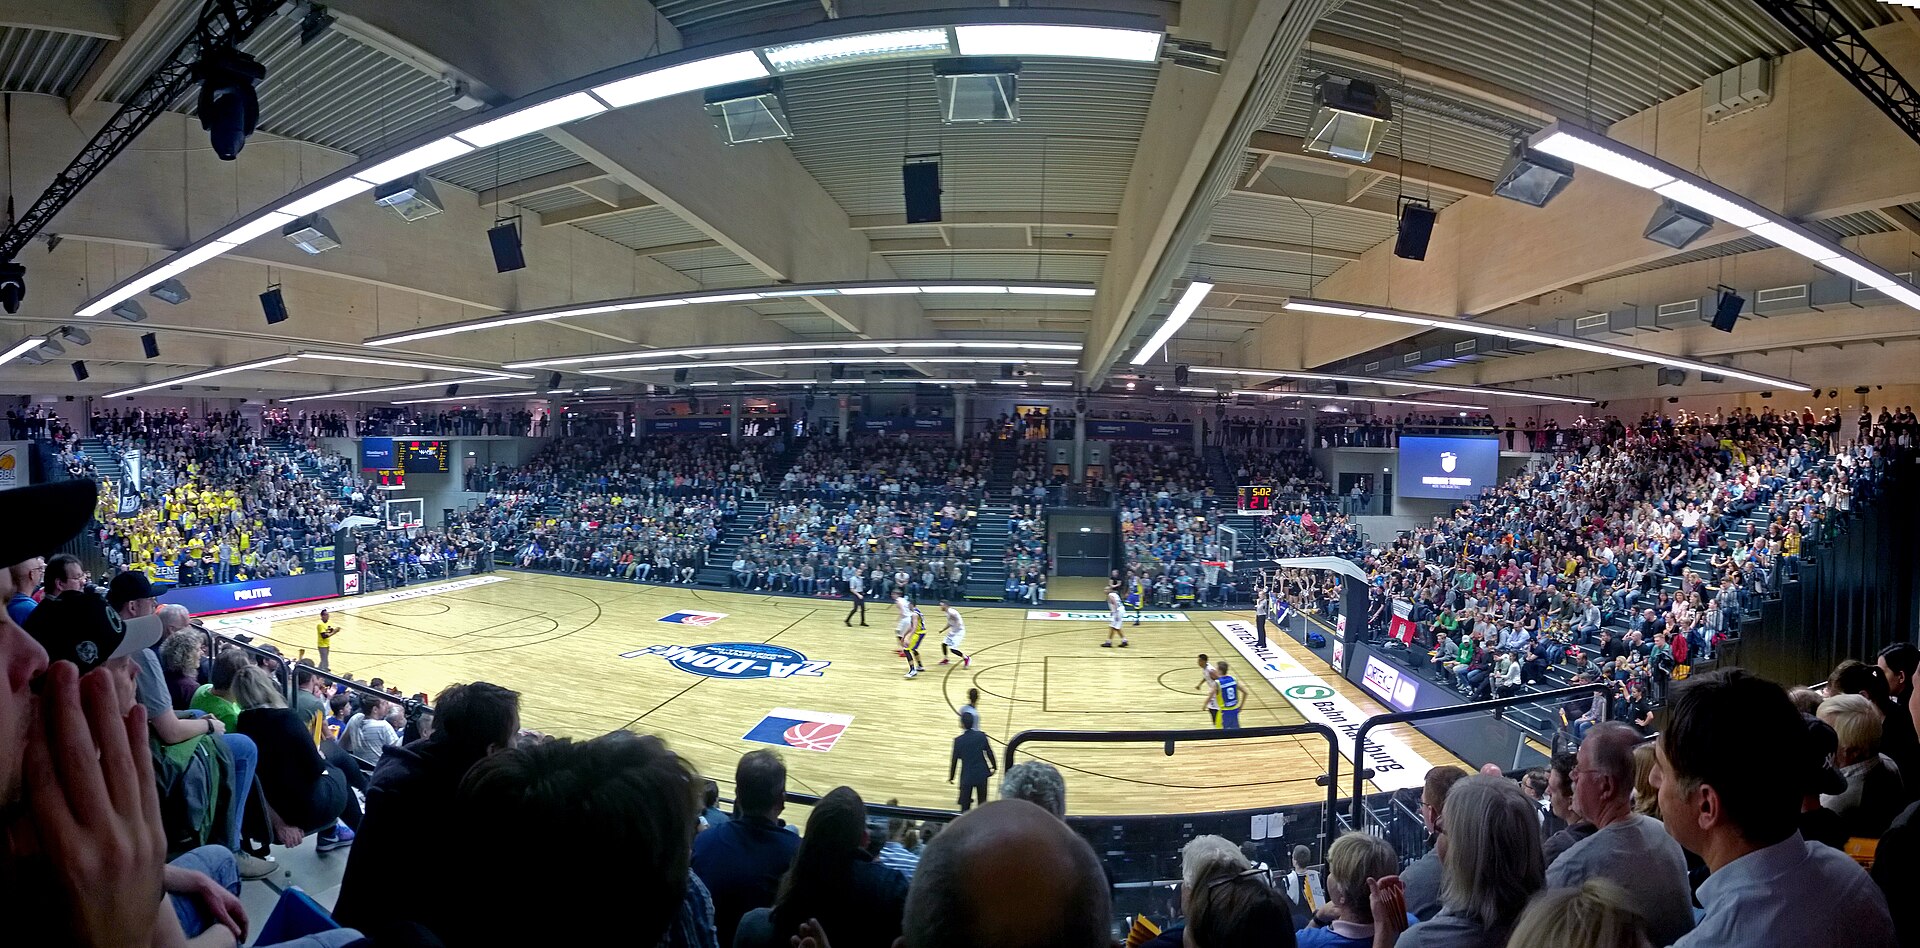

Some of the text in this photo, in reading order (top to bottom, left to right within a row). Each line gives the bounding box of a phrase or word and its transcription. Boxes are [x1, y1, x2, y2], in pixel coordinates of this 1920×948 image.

[1252, 487, 1272, 496] 5:02
[1249, 496, 1269, 509] 21
[233, 587, 273, 601] POLITIK
[1312, 701, 1348, 723] Bahn
